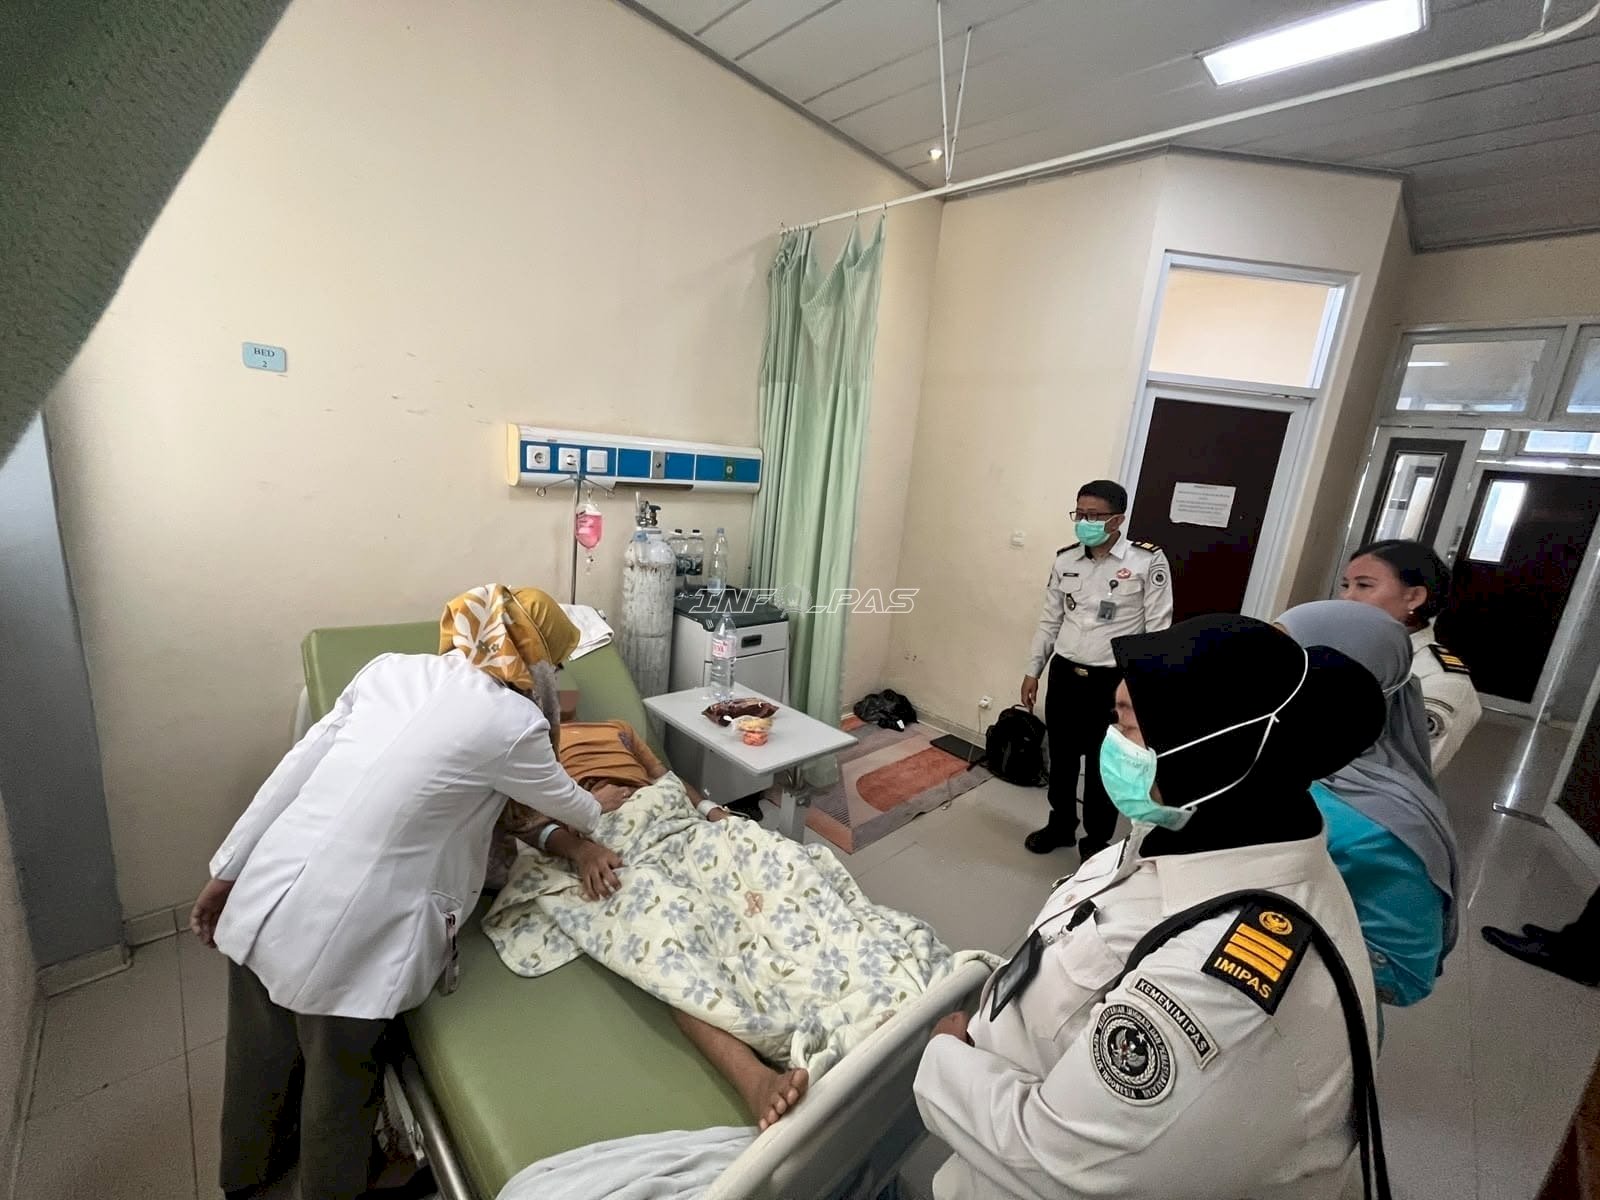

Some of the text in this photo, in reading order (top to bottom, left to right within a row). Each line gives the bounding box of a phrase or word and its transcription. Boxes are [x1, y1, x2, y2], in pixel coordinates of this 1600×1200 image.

[253, 347, 275, 357] BED
[262, 360, 268, 368] 2
[1213, 956, 1273, 999] IMIPAS
[1137, 981, 1208, 1051] KEMENIMIPAS
[1101, 1069, 1137, 1099] INDONESIA
